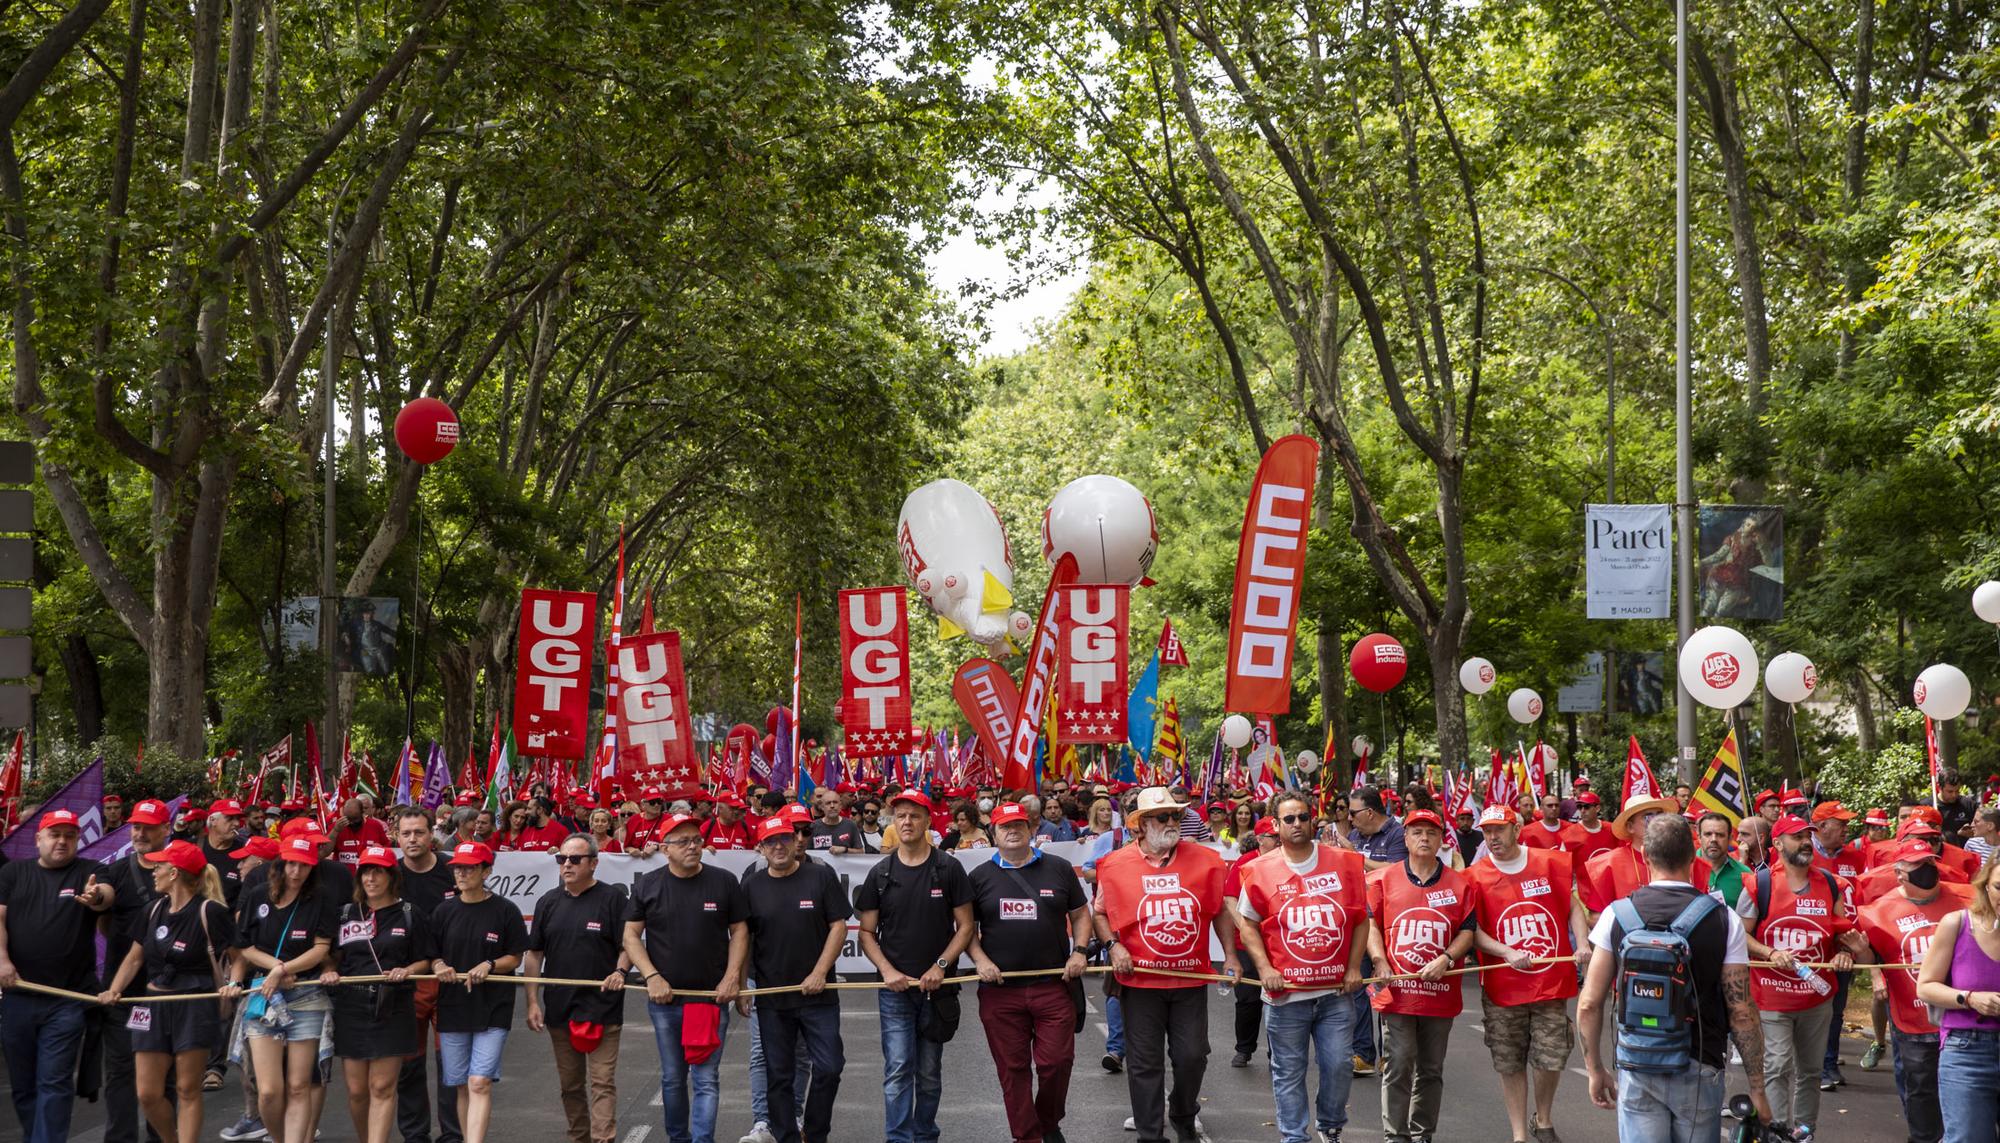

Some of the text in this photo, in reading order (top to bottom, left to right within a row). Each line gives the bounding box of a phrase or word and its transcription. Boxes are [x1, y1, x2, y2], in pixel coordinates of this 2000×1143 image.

[1592, 519, 1666, 549] Paret
[1236, 483, 1305, 679] CCOO
[528, 599, 584, 712] UGT
[1069, 588, 1117, 704] UGT
[848, 592, 901, 730] UGT
[1704, 653, 1733, 674] UGT
[617, 643, 678, 765] UGT
[483, 874, 540, 897] 2022
[1146, 878, 1176, 888] NO+
[1307, 876, 1336, 891] NO+
[1521, 879, 1539, 890] UGT
[1426, 890, 1444, 900] UGT
[1796, 898, 1816, 907] UGT
[1003, 902, 1034, 913] NO+
[1145, 897, 1195, 926] UGT
[1287, 903, 1338, 932] UGT
[1397, 918, 1448, 950] UGT
[1503, 912, 1551, 946] UGT
[1773, 926, 1823, 951] UGT
[1284, 966, 1313, 977] mano
[1423, 981, 1450, 992] mano
[1634, 984, 1663, 998] LiveU
[1760, 977, 1792, 989] mano
[133, 1010, 150, 1022] NO+
